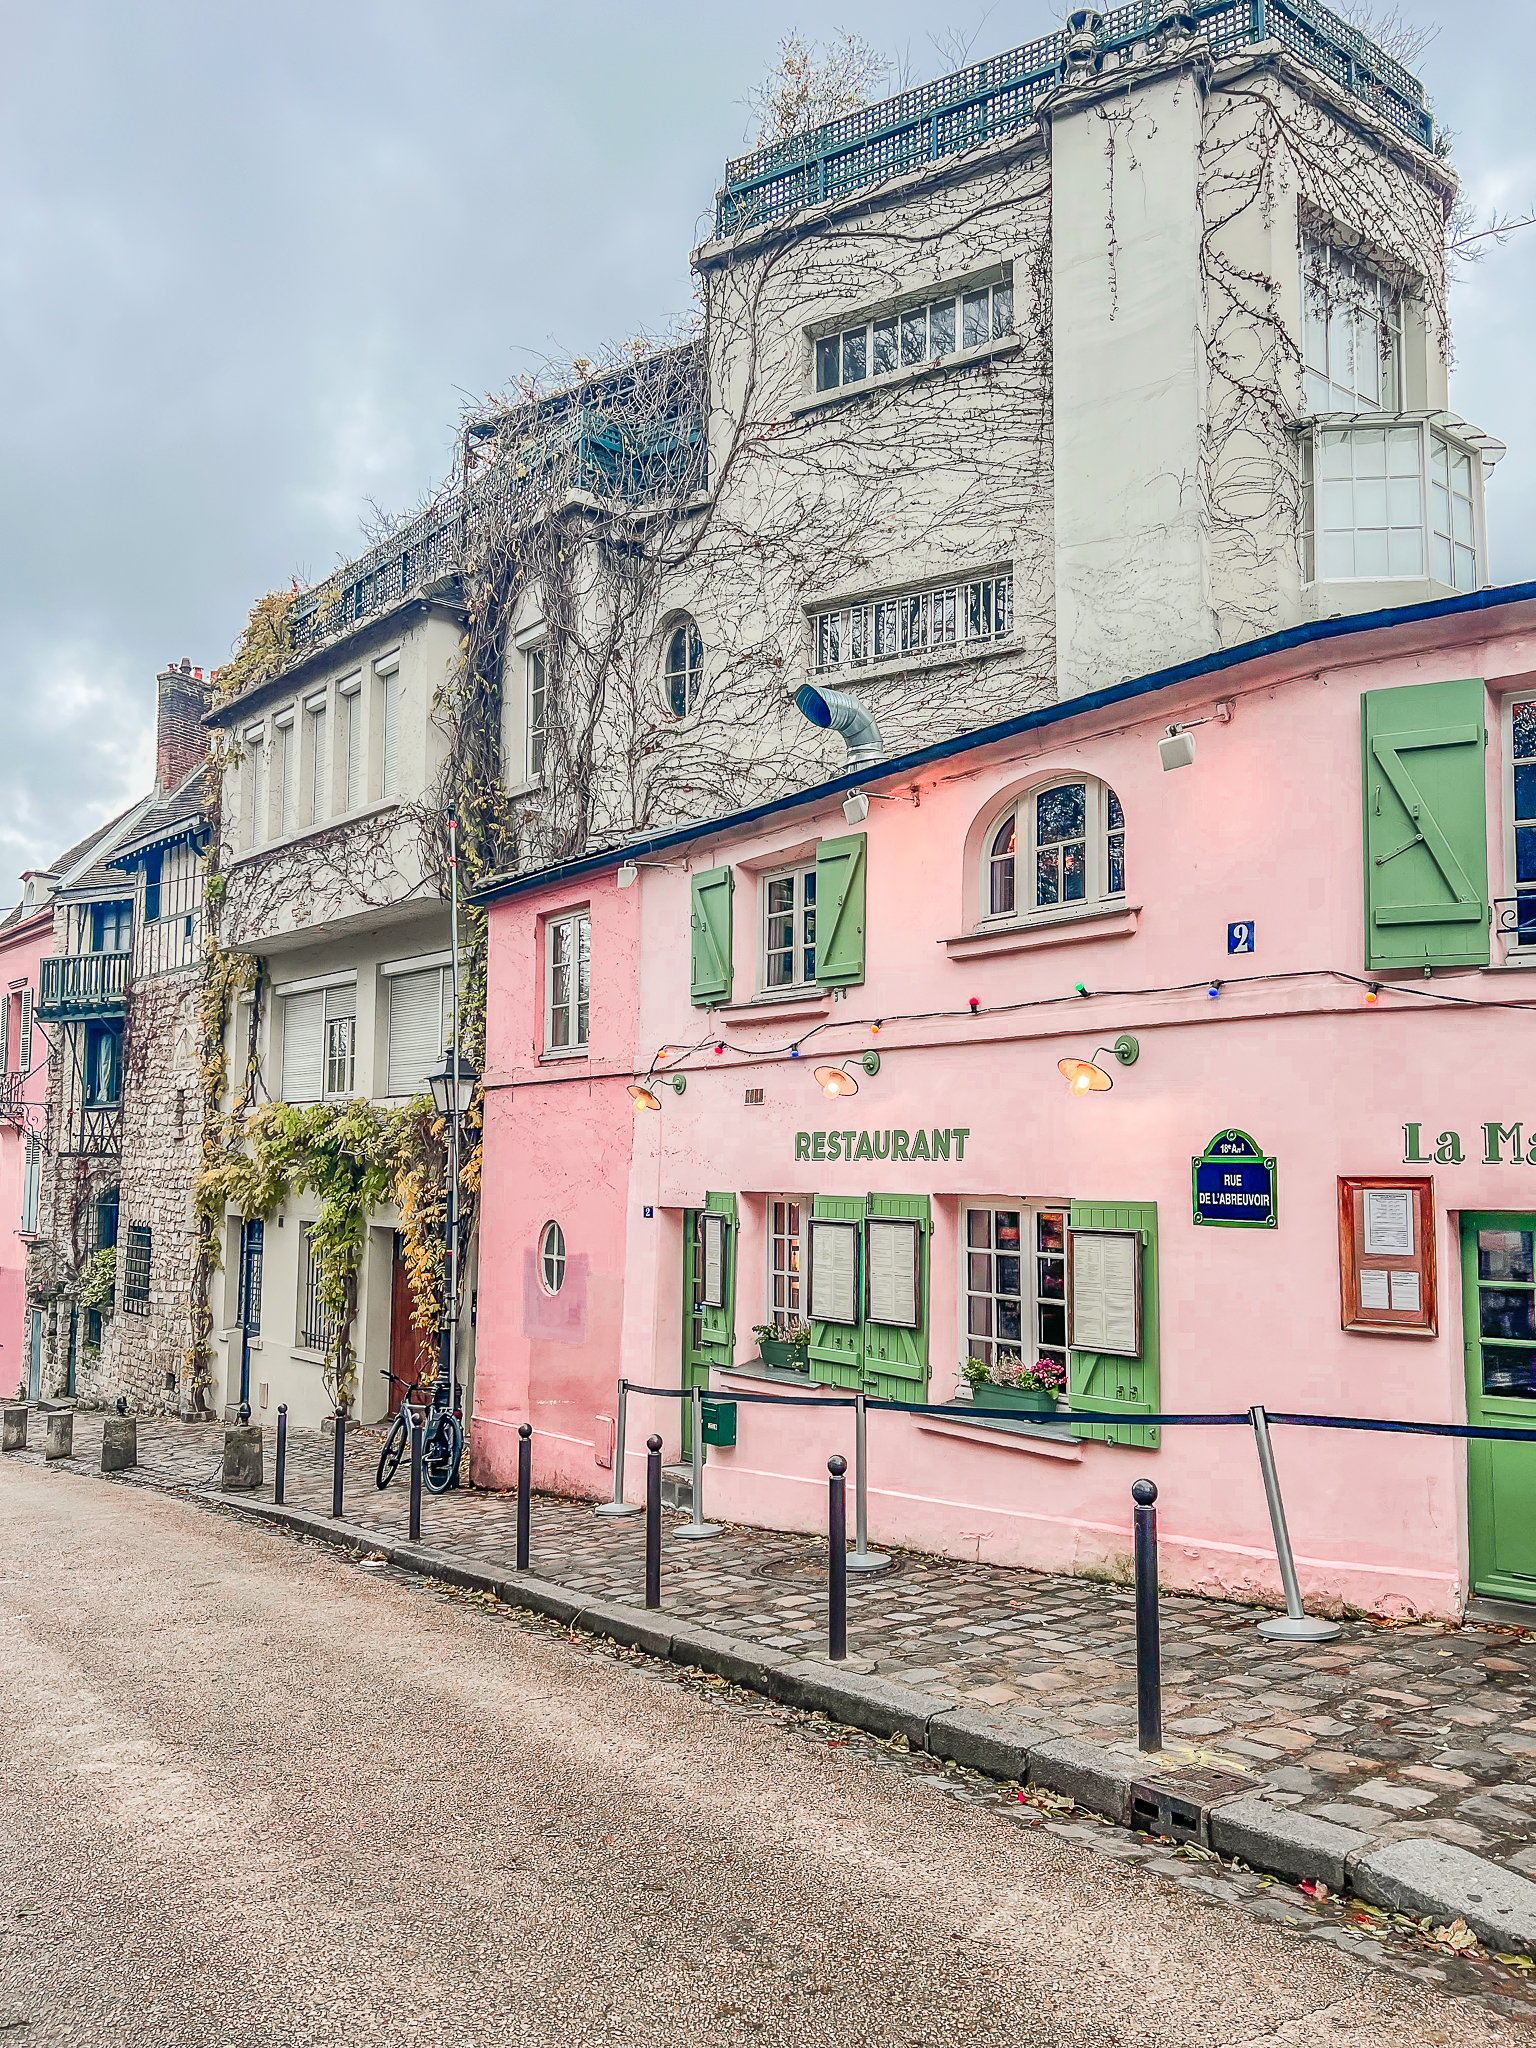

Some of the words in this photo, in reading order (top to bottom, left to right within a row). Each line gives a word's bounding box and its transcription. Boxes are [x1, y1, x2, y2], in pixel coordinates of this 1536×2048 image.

[1233, 924, 1249, 953] 2
[795, 1128, 970, 1161] RESTAURANT
[1402, 1122, 1466, 1165] La
[1224, 1174, 1242, 1186] RUE
[1199, 1192, 1211, 1204] DE
[1212, 1192, 1270, 1206] L'ABREUVOIR
[645, 1207, 651, 1217] 2
